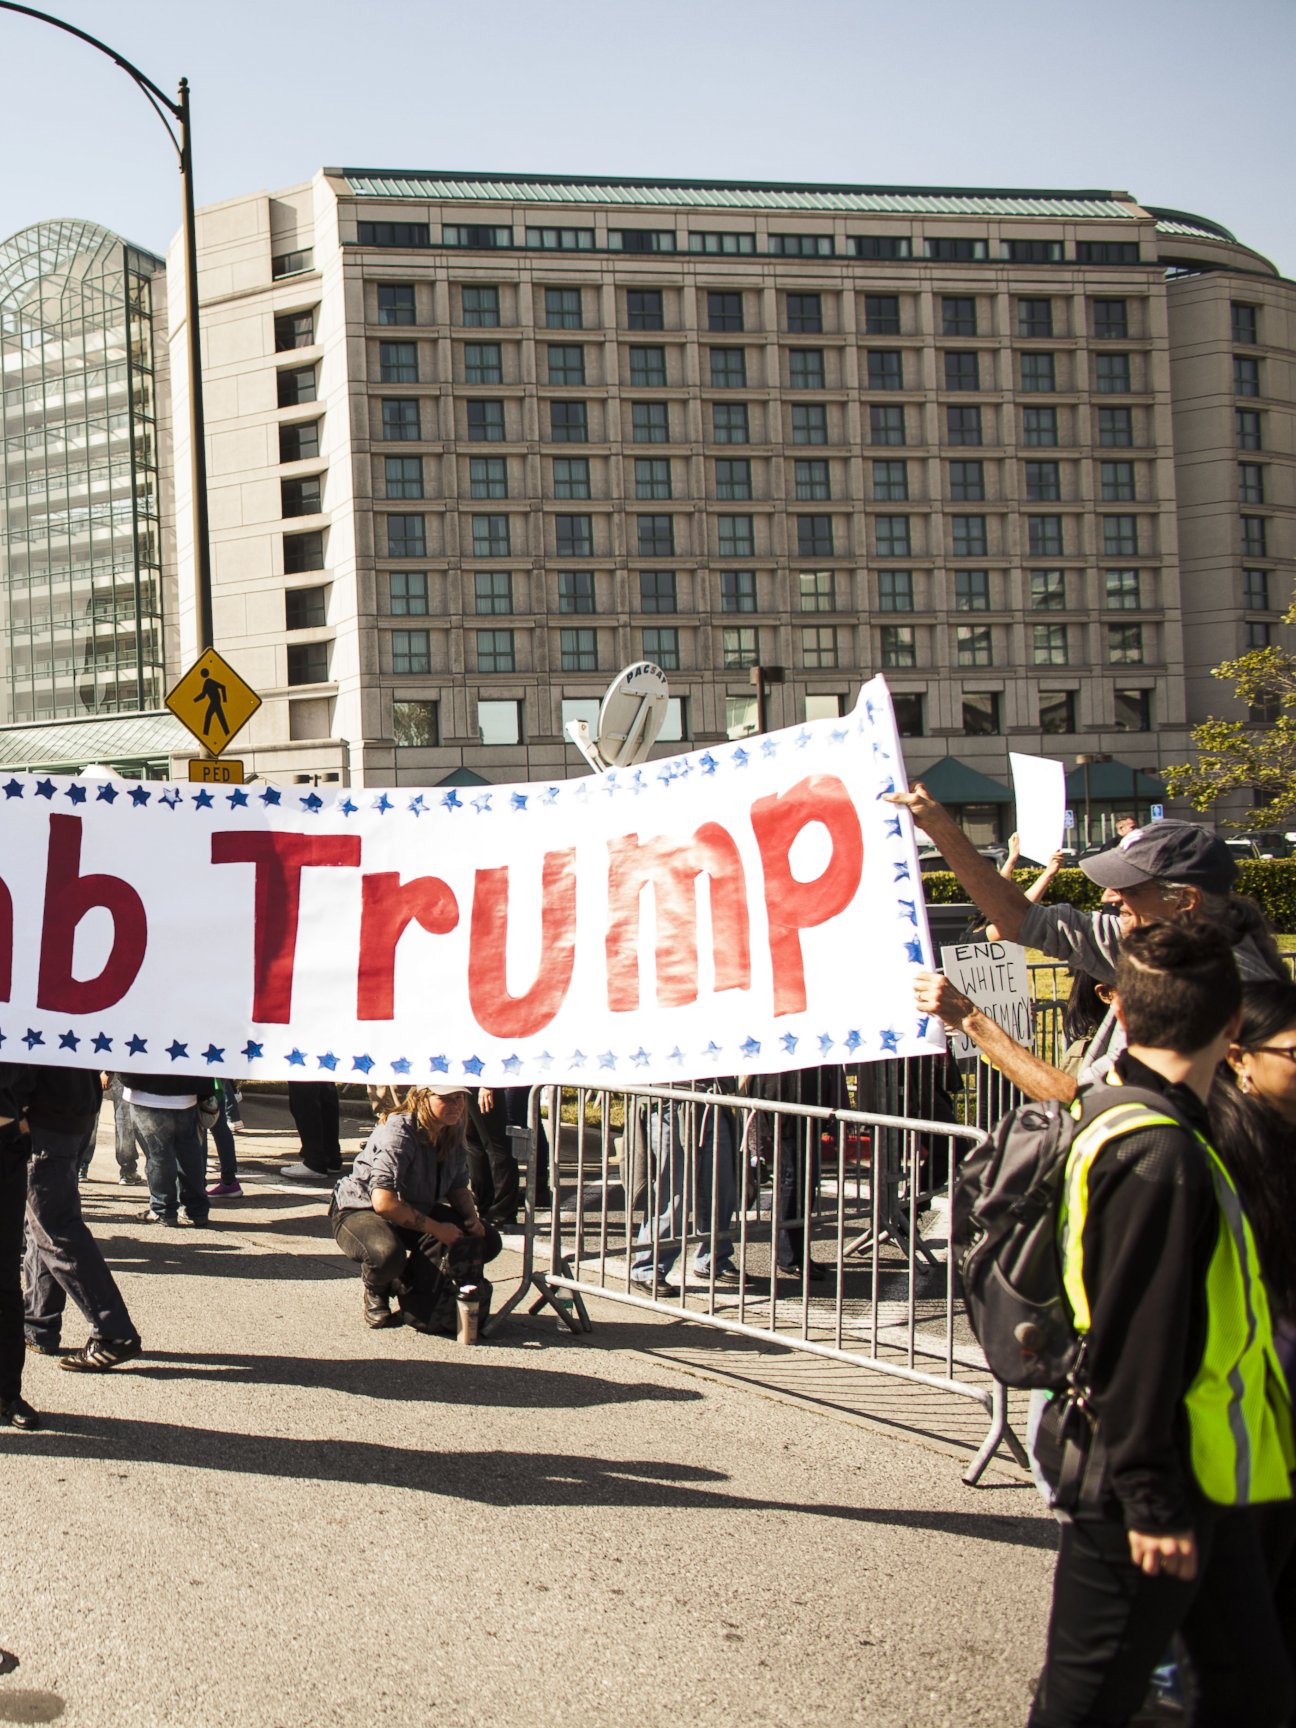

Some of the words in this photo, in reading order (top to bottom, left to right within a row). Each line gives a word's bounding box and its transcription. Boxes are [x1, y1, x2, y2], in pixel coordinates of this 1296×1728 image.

[626, 664, 667, 684] PACSAT
[202, 766, 230, 782] PED
[210, 773, 864, 1039] Trump
[955, 942, 1006, 961] END
[959, 962, 1017, 995] WHITE
